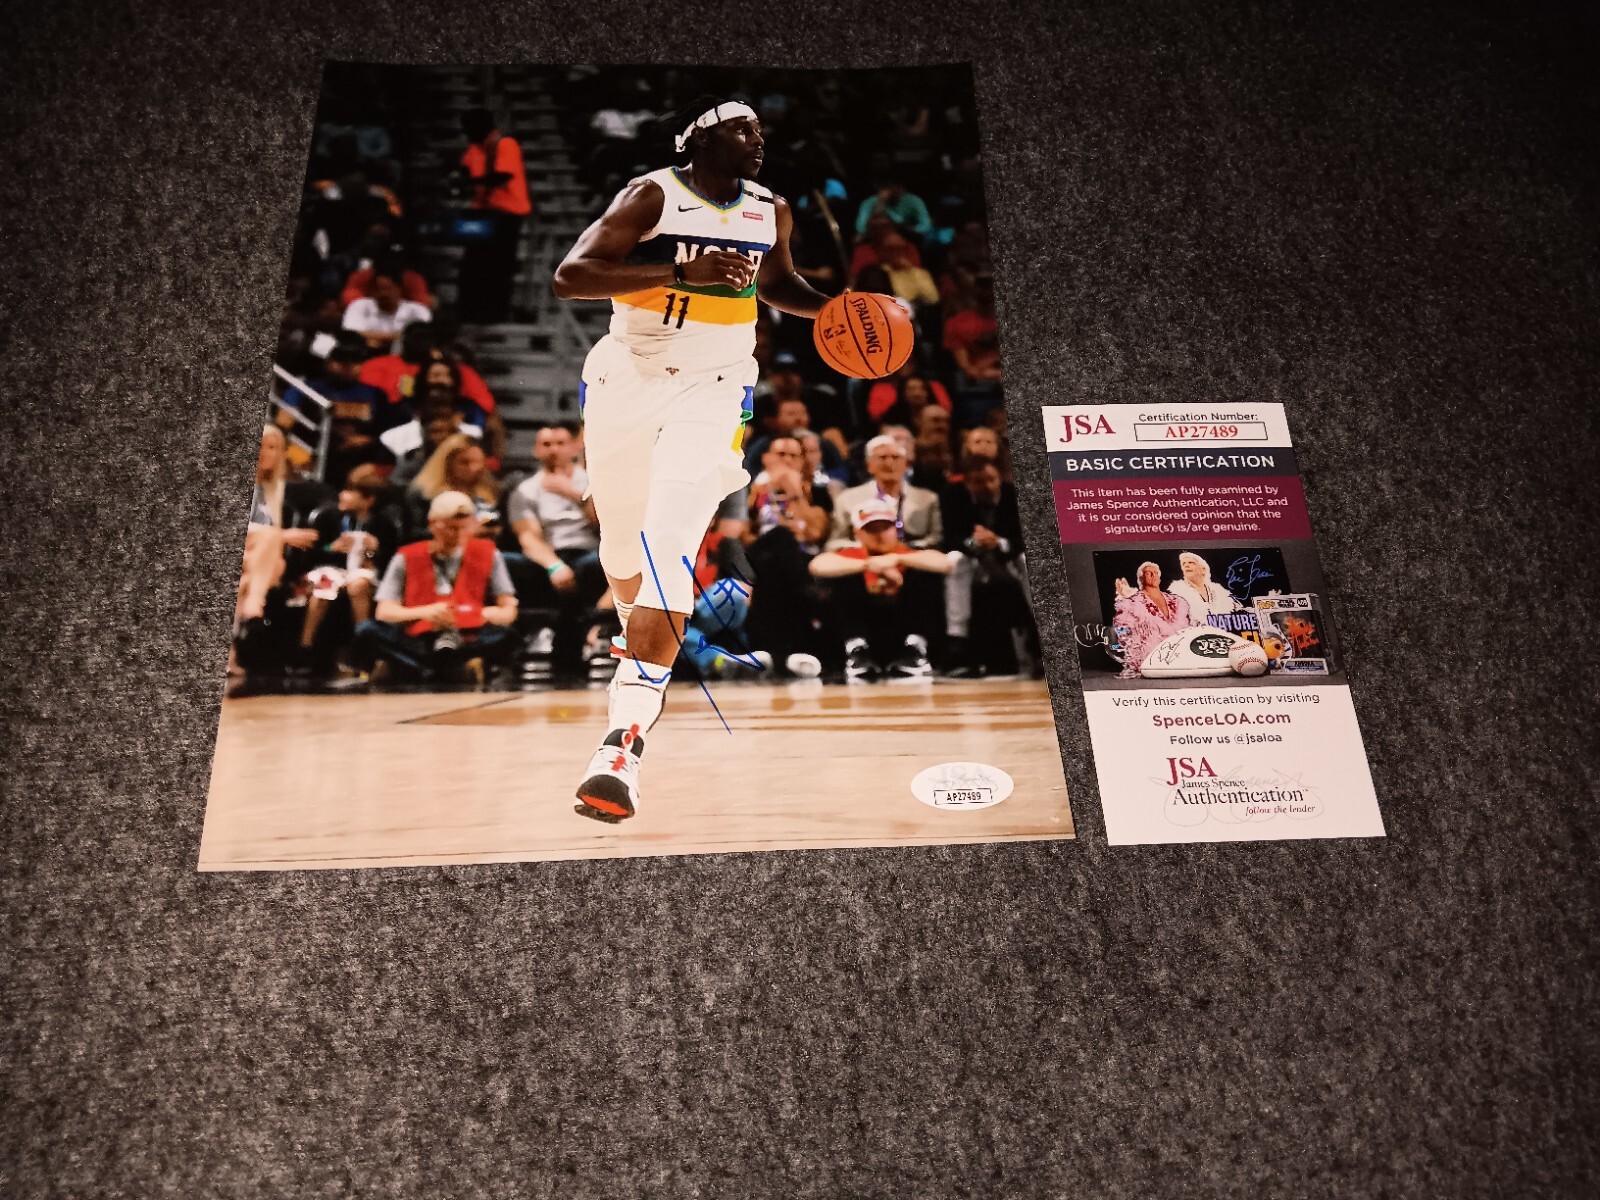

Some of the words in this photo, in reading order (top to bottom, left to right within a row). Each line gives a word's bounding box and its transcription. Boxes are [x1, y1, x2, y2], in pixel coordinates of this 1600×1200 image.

[662, 293, 690, 329] 11
[849, 297, 883, 354] SPALDING
[1139, 413, 1208, 422] Certification
[1212, 412, 1259, 422] Number:
[1060, 414, 1116, 442] JSA
[1166, 425, 1238, 438] AP27489
[1067, 456, 1124, 472] BASIC
[1129, 455, 1275, 470] CERTIFICATION
[1071, 488, 1095, 498] This
[1098, 487, 1123, 497] item
[1127, 486, 1146, 496] has
[1150, 486, 1177, 496] been
[1180, 485, 1205, 497] fully
[1208, 484, 1263, 495] examined
[1266, 484, 1279, 496] by
[1067, 500, 1104, 510] James
[1107, 499, 1149, 511] Spence
[1153, 498, 1239, 508] Authentication,
[1243, 497, 1265, 506] LLC
[1268, 496, 1289, 506] and
[1078, 513, 1086, 522] it
[1090, 513, 1099, 522] is
[1102, 513, 1121, 522] our
[1125, 511, 1188, 522] considered
[1192, 510, 1234, 521] opinion
[1237, 509, 1260, 519] that
[1262, 509, 1282, 518] the
[1105, 523, 1174, 535] signature(s)
[1177, 522, 1209, 533] is/are
[1213, 521, 1261, 534] genuine.
[1207, 613, 1258, 631] NATURE
[1112, 695, 1149, 707] Verify
[1153, 695, 1176, 706] this
[1180, 692, 1253, 705] certification
[1258, 692, 1272, 704] by
[1275, 692, 1320, 704] visiting
[1152, 712, 1291, 728] SpenceLOA.com
[1170, 735, 1212, 744] Follow
[1217, 735, 1230, 743] us
[1234, 733, 1282, 745] @jsaloa
[1166, 756, 1218, 786] JSA
[1181, 779, 1210, 788] James
[1211, 778, 1246, 788] Spence
[946, 791, 982, 802] AP27489
[1246, 805, 1271, 816] follow
[1274, 804, 1287, 814] the
[1289, 804, 1315, 813] leader
